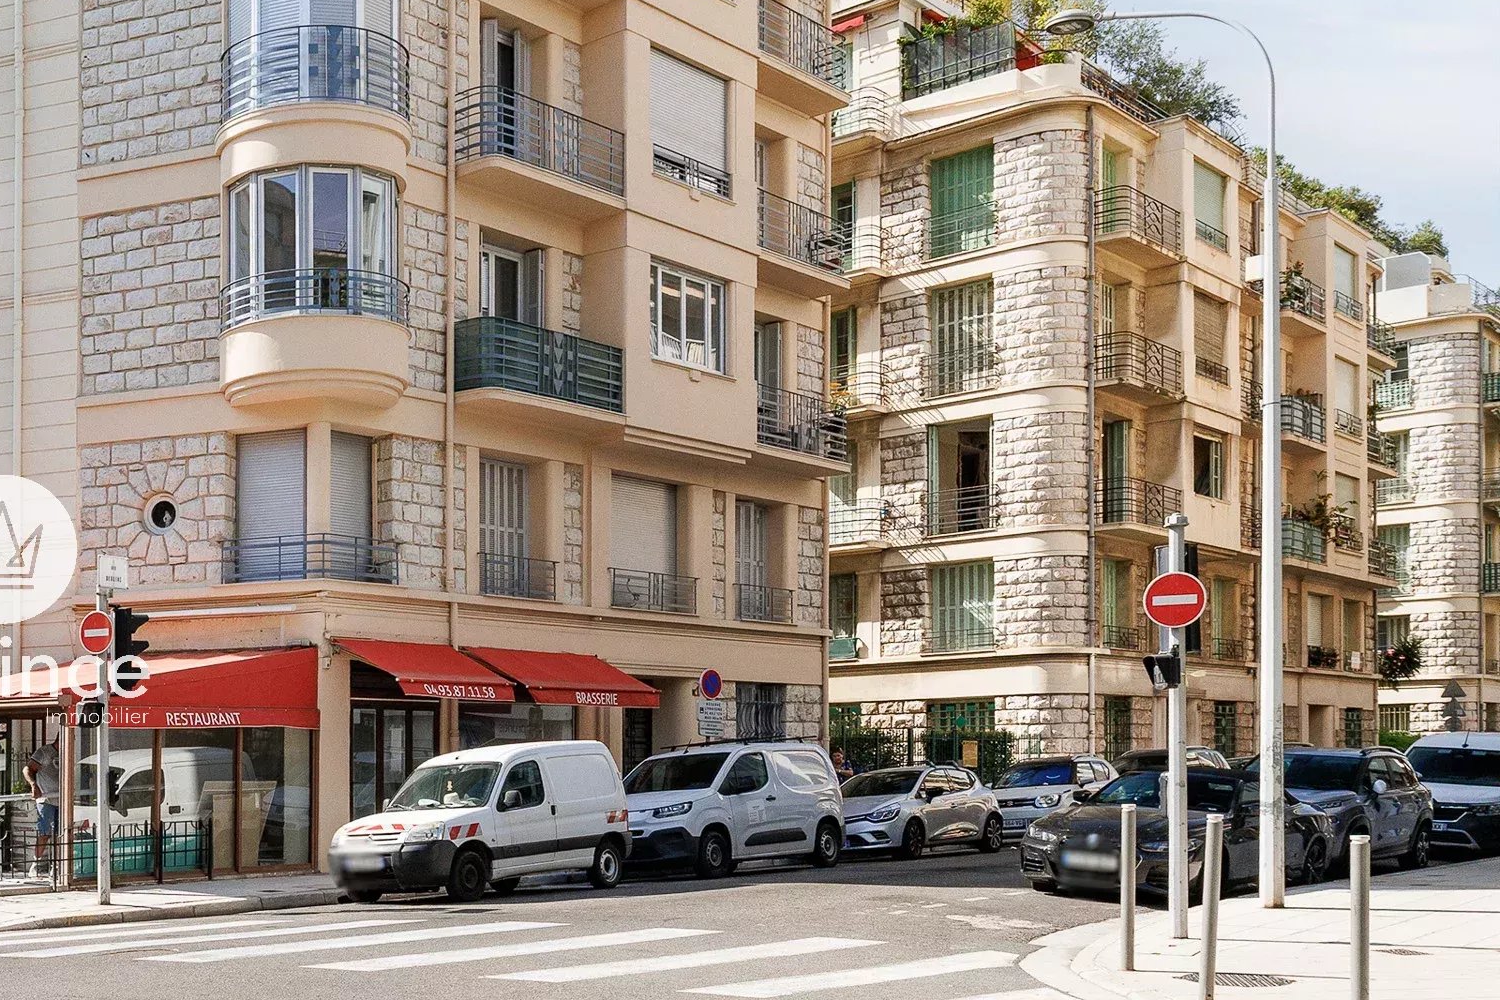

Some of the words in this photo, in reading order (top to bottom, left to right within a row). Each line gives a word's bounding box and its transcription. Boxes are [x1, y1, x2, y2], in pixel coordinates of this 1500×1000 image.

[423, 683, 496, 699] 04.93.87.11.58
[575, 691, 619, 706] BRASSERIE
[165, 712, 241, 726] RESTAURANT
